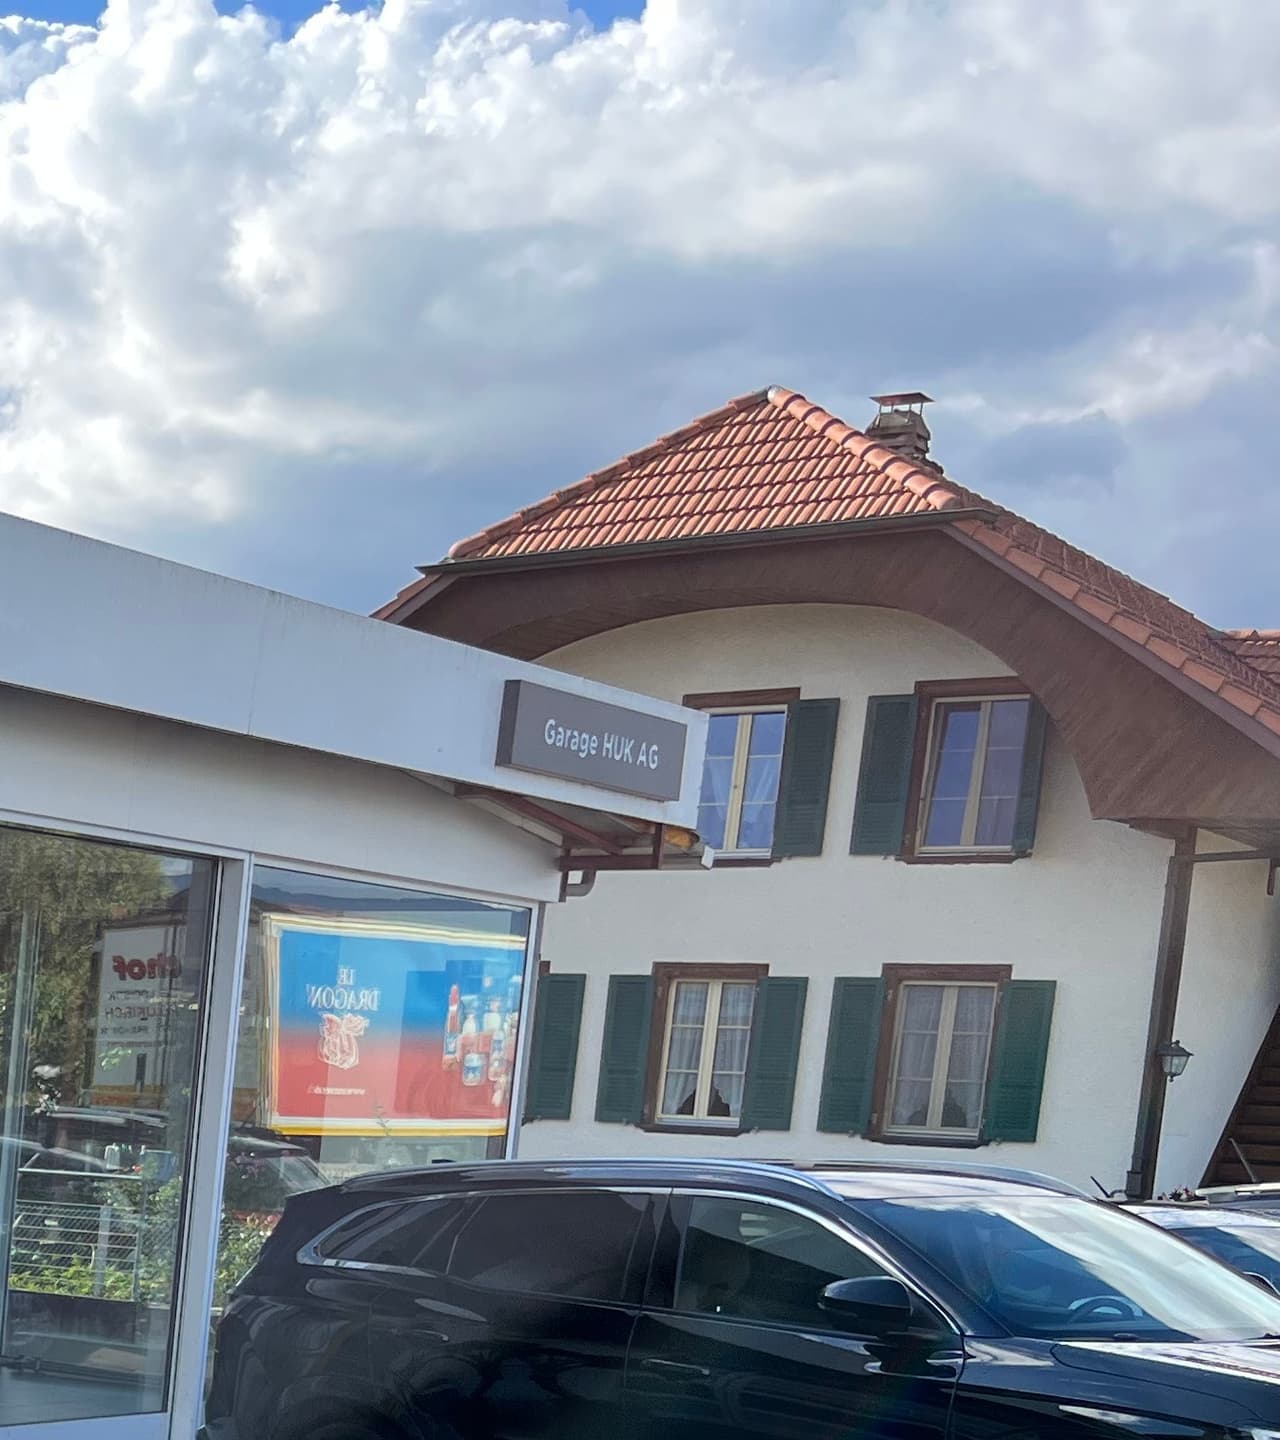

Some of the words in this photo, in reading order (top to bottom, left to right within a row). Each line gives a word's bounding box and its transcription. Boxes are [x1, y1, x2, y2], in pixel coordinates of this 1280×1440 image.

[544, 719, 598, 759] Garage
[602, 732, 634, 764] HUK
[636, 742, 659, 770] AG
